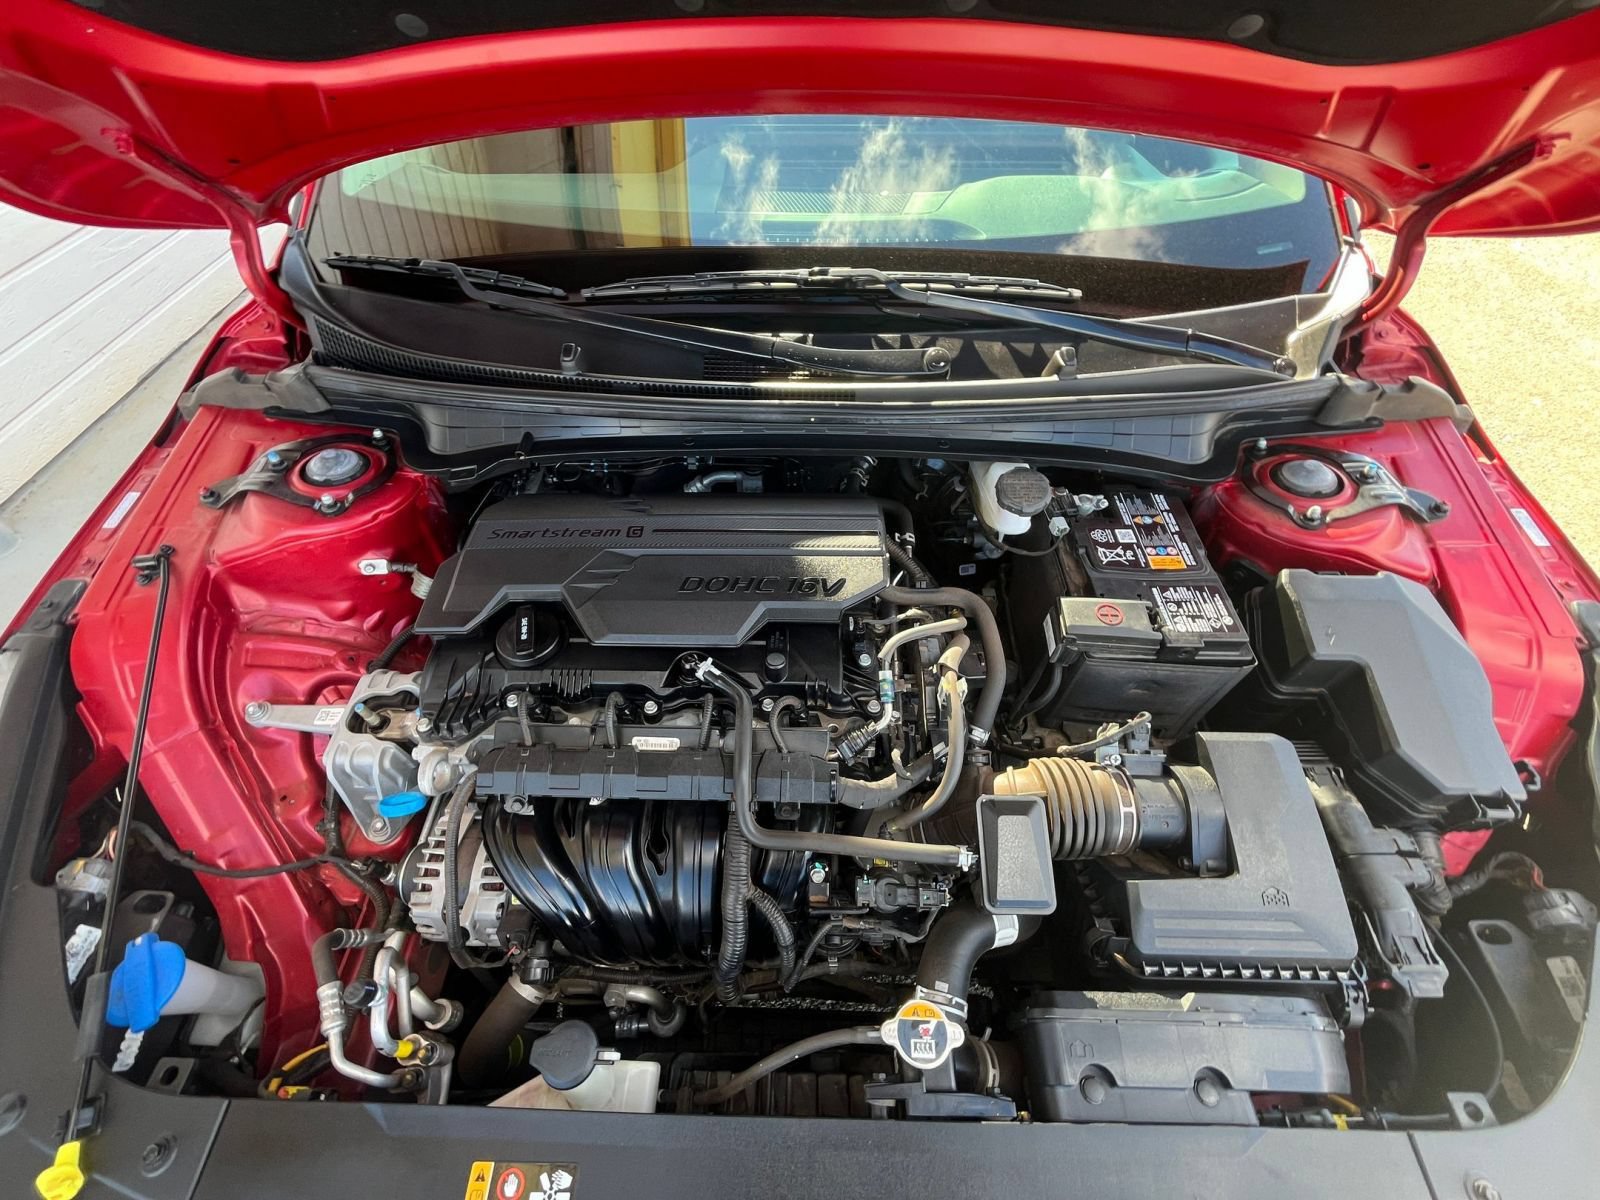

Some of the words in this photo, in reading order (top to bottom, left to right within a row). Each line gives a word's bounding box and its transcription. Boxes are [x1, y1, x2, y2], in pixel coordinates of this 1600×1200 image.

[487, 527, 621, 540] Smartstream
[677, 575, 780, 594] DOHC
[787, 576, 847, 598] 16V
